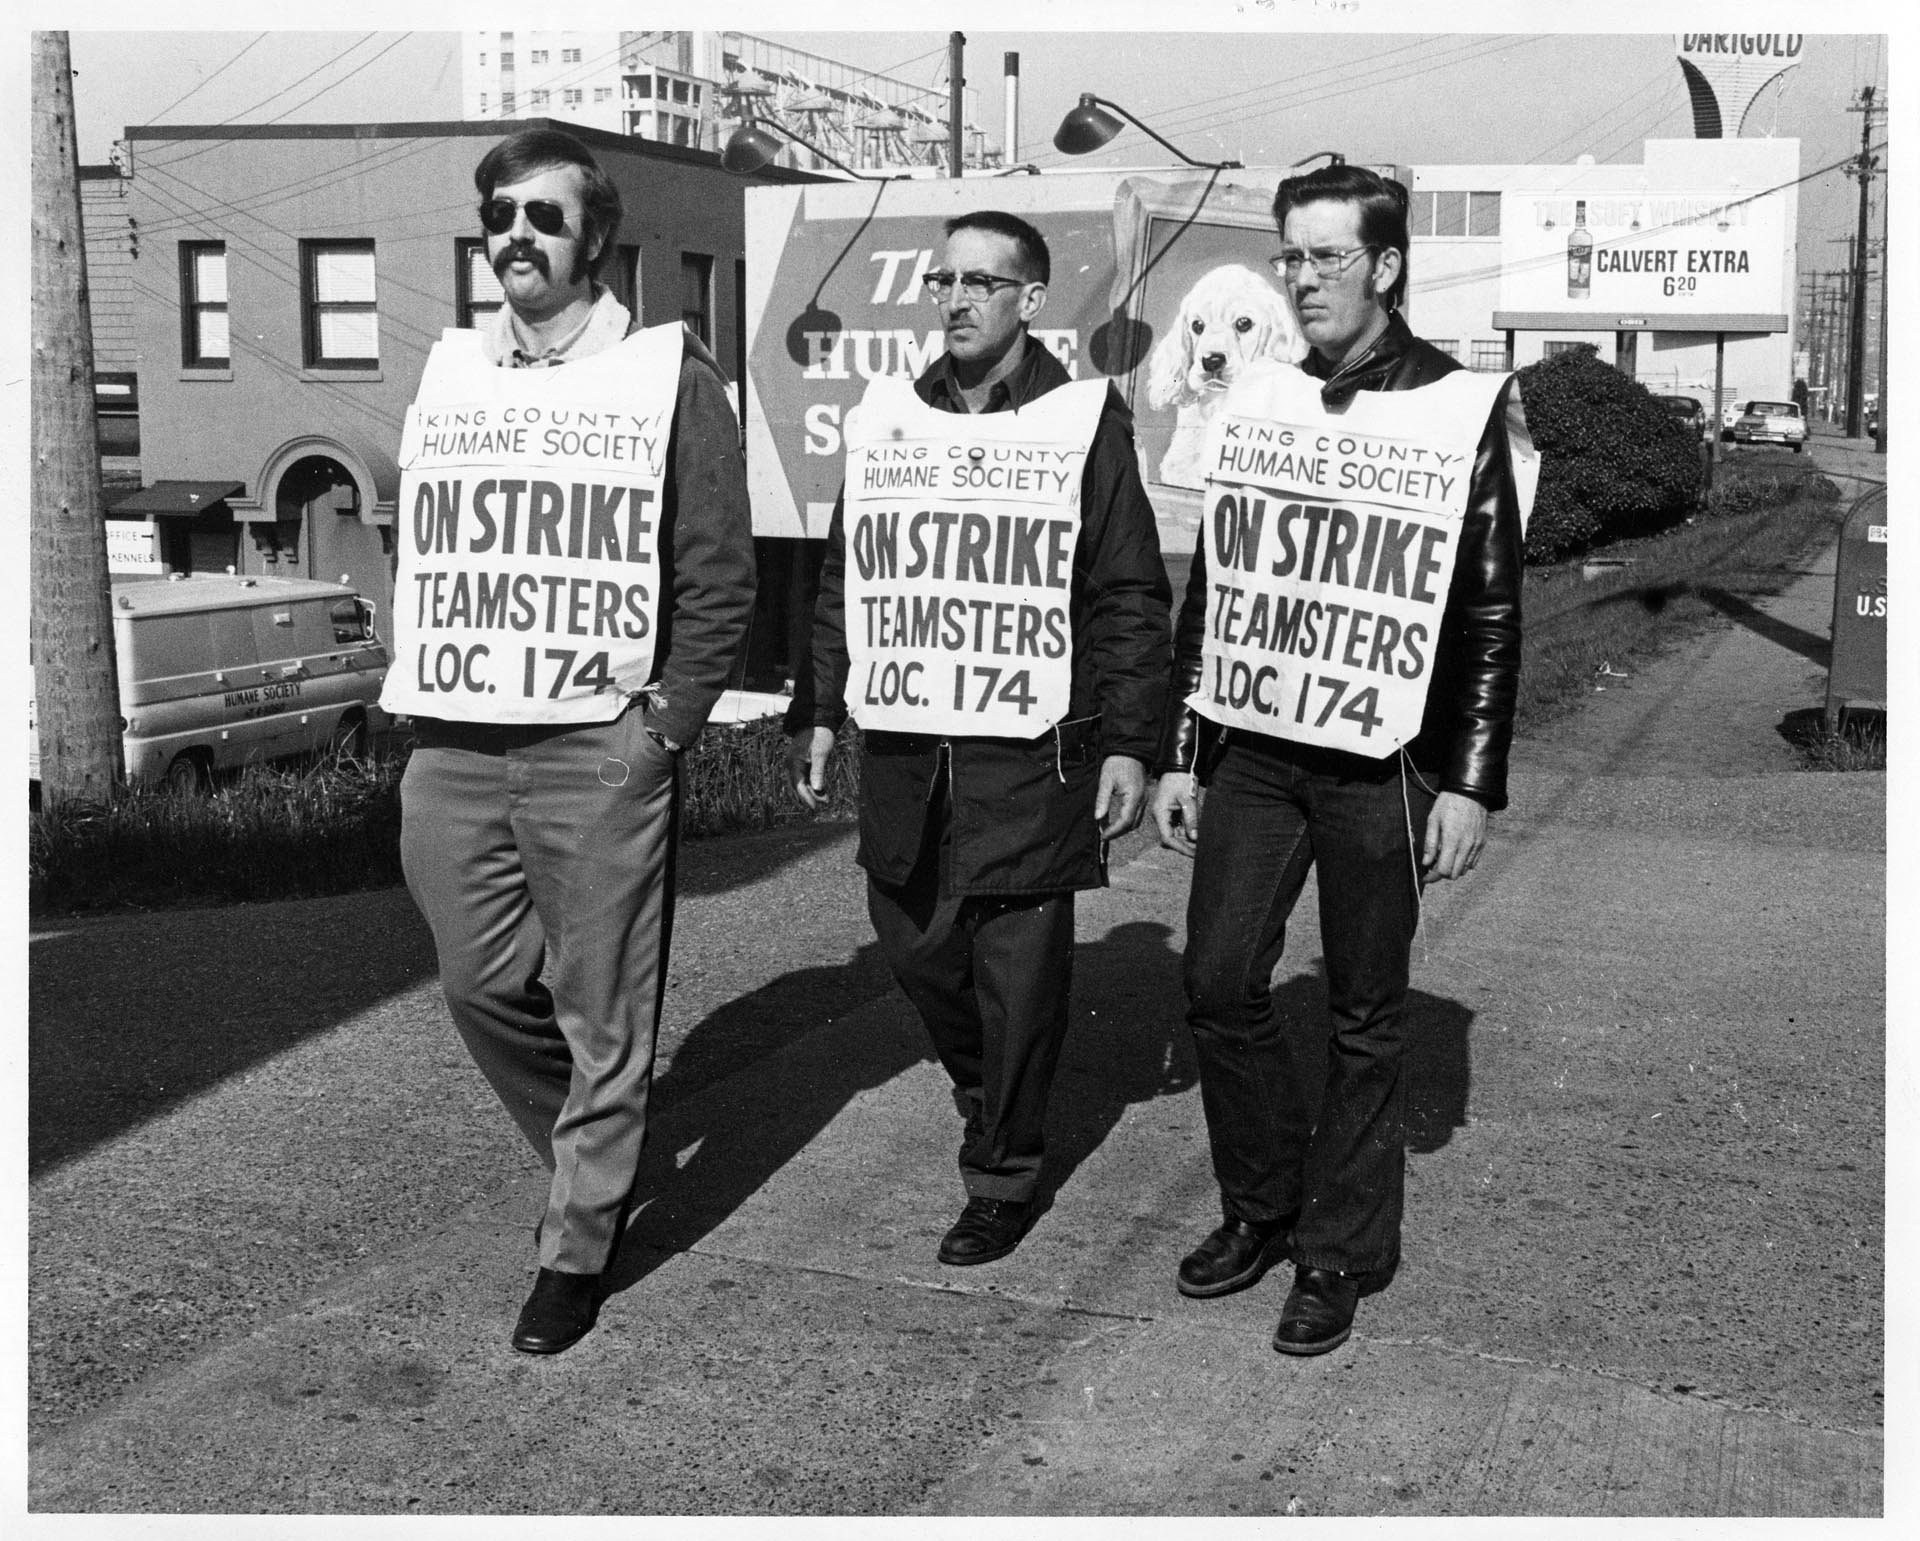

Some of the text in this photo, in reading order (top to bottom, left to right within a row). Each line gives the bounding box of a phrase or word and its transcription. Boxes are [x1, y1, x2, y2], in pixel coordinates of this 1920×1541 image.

[1683, 33, 1803, 58] DARIGOLD
[870, 249, 941, 305] Th
[1597, 249, 1678, 273] CALVERT
[1686, 249, 1750, 273] EXTRA
[803, 328, 1079, 381] HUME
[422, 428, 657, 462] HUMANE SOCIETY
[427, 407, 649, 432] KING COUNTY
[1225, 423, 1454, 469] KING COUNTY
[863, 466, 1070, 493] HUMANE SOCIETY
[866, 446, 1071, 465] KING COUNTY
[1218, 444, 1456, 502] HUMANE SOCIETY
[106, 530, 137, 542] FFICE
[414, 479, 656, 565] ON STRIKE
[1214, 494, 1449, 605] ON STRIKE
[853, 511, 1073, 590] ON STRIKE
[414, 571, 650, 639] TEAMSTERS
[860, 596, 1067, 660] TEAMSTERS
[1213, 583, 1429, 681] TEAMSTERS
[224, 684, 300, 708] HUMANE SOCIETY
[417, 643, 617, 699] LOC. 174
[864, 661, 1038, 716] LOC. 174
[1213, 654, 1385, 738] LOC. 174
